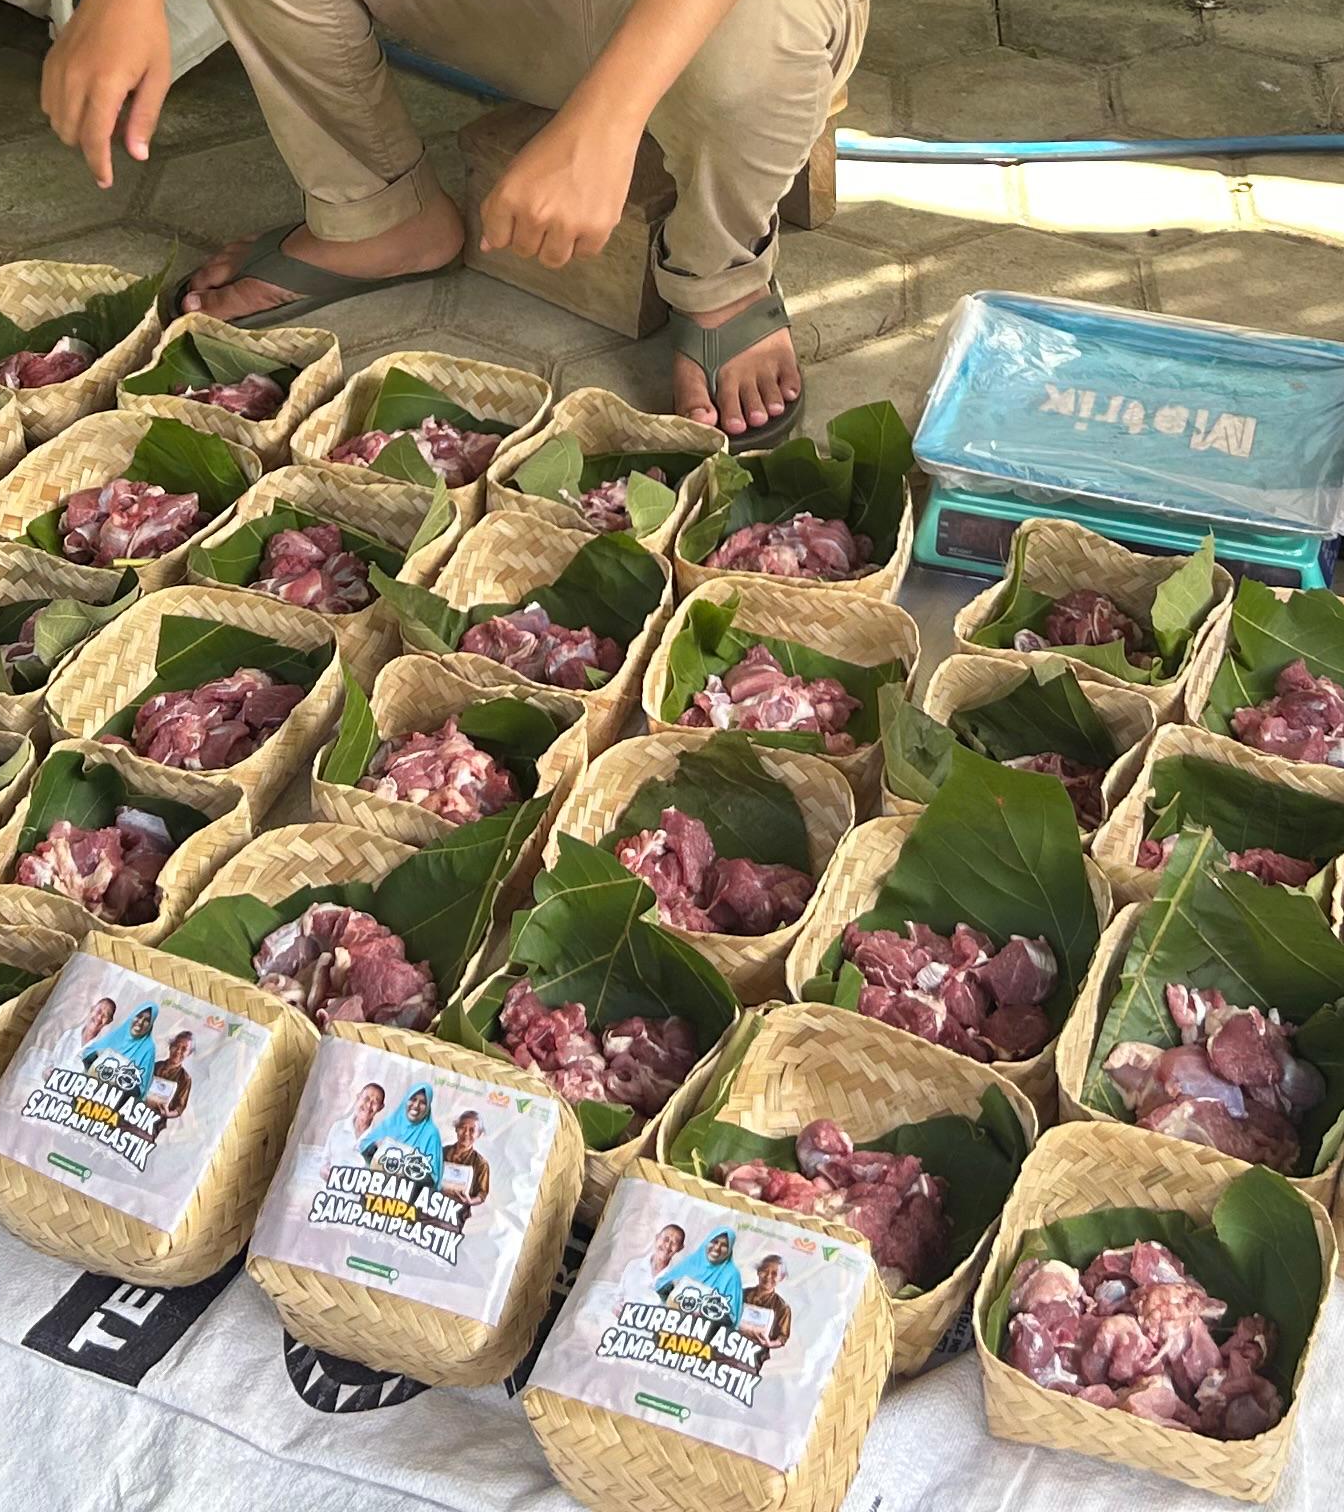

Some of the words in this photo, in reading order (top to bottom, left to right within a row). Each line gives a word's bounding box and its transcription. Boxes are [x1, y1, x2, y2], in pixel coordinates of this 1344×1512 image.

[22, 1090, 92, 1136] SAMPAH
[89, 1119, 157, 1173] PLASTIK
[45, 1069, 123, 1112] KURBAN
[117, 1096, 161, 1137] ASIK
[73, 1096, 120, 1127] TANPA
[308, 1191, 388, 1233] SAMPAH
[387, 1215, 465, 1266] PLASTIK
[327, 1165, 414, 1203] KURBAN
[413, 1184, 465, 1227] ASIK
[364, 1193, 416, 1222] TANPA
[596, 1328, 682, 1372] SAMPAH
[679, 1352, 761, 1407] PLASTIK
[618, 1303, 711, 1340] KURBAN
[711, 1326, 763, 1369] ASIK
[657, 1331, 713, 1360] TANPA
